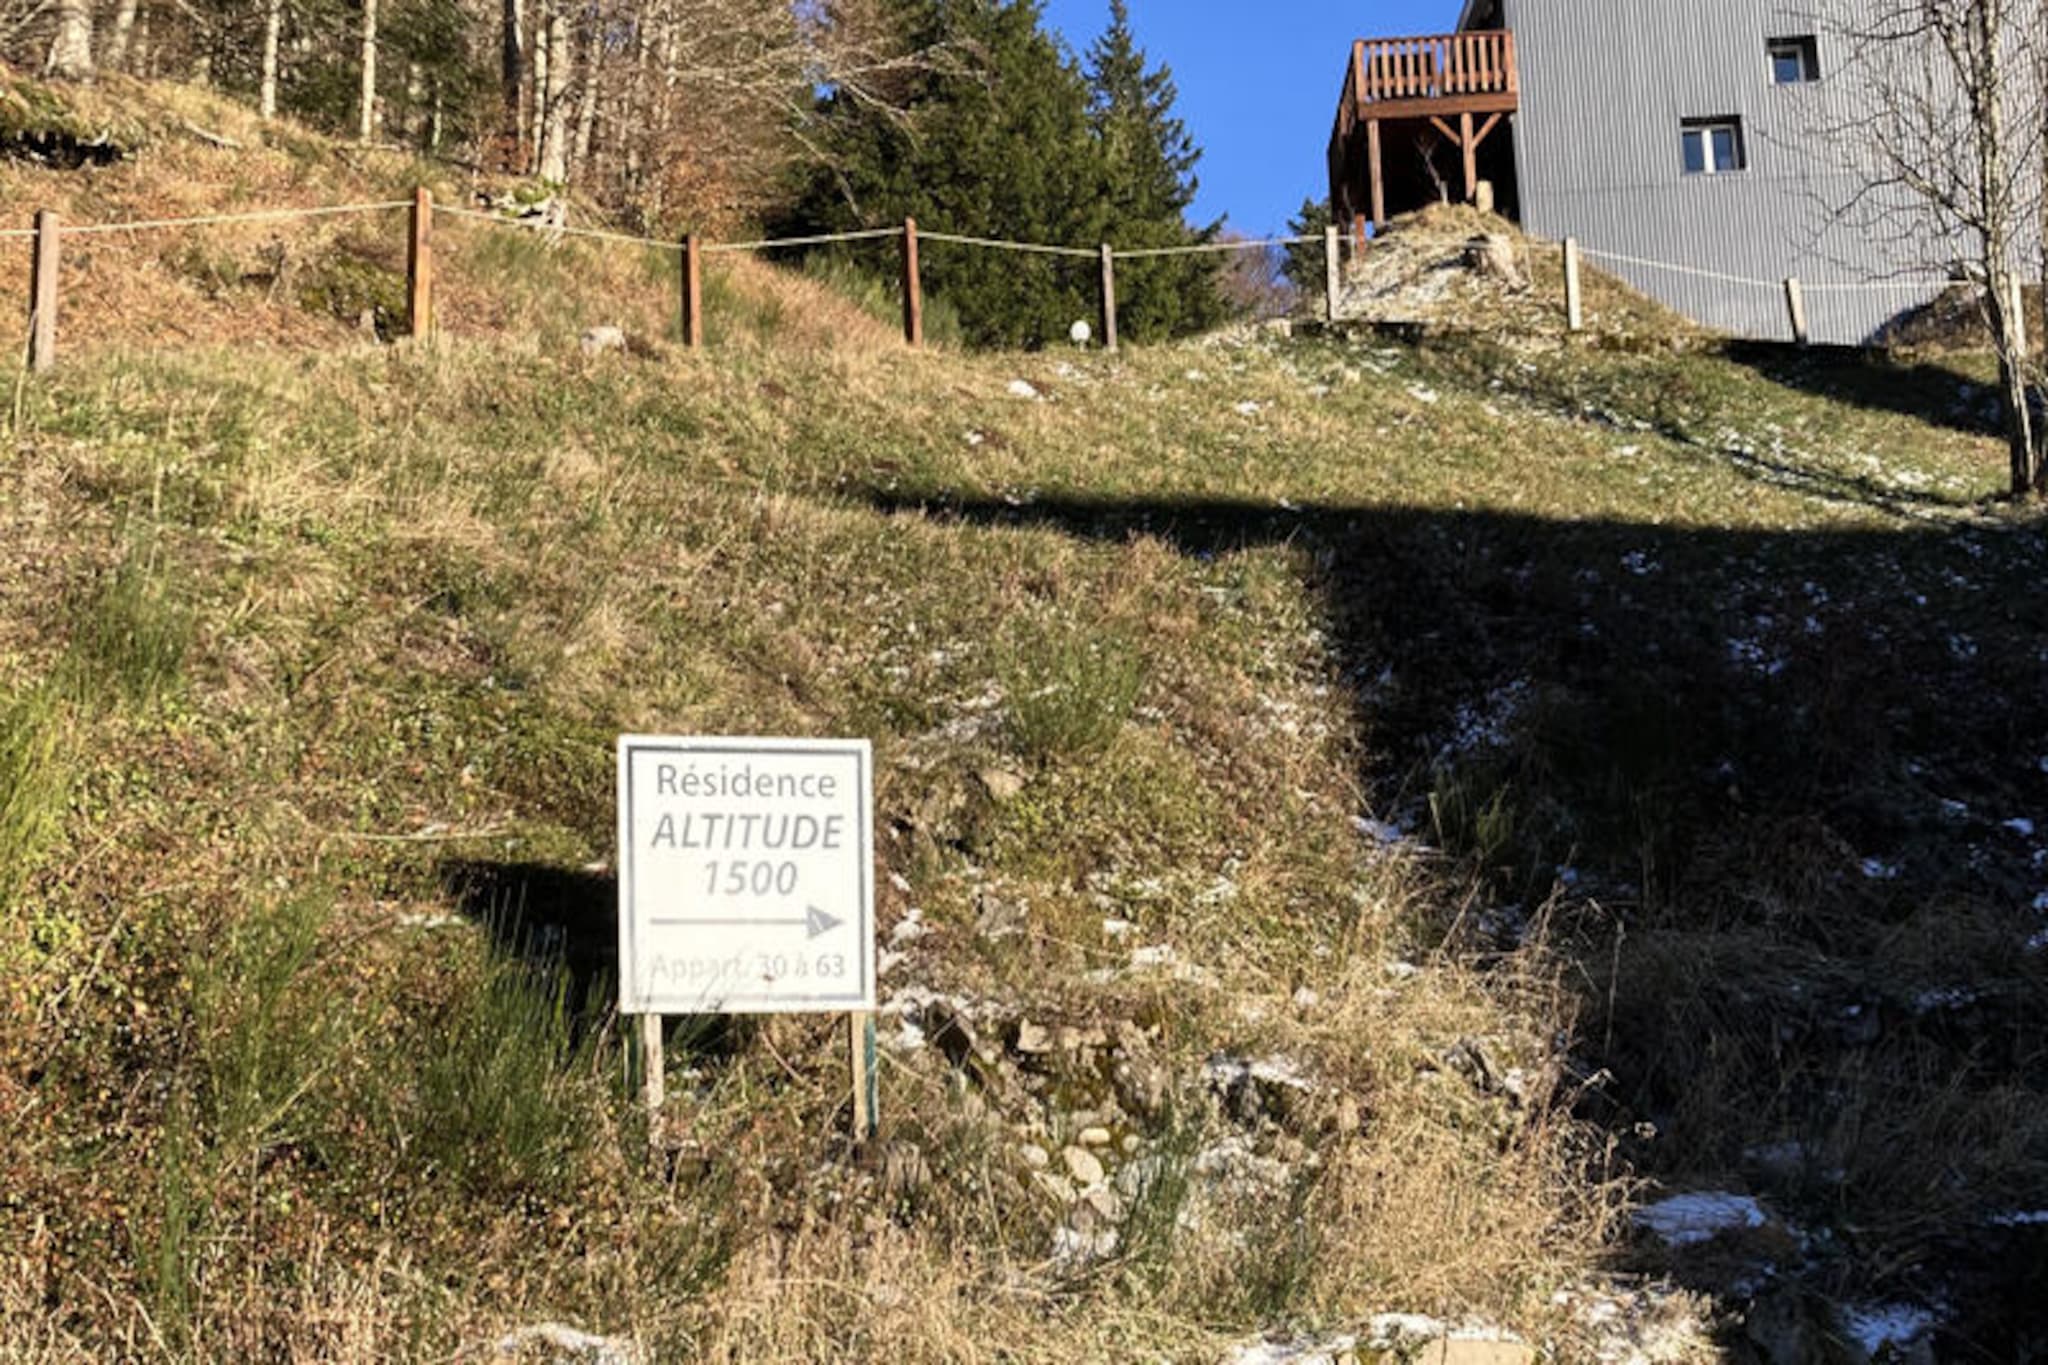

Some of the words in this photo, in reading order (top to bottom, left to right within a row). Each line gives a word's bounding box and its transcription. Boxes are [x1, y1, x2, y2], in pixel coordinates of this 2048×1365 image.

[657, 764, 836, 798] Résidence
[651, 813, 844, 849] ALTITUDE
[705, 860, 798, 896] 1500
[816, 954, 845, 978] 63
